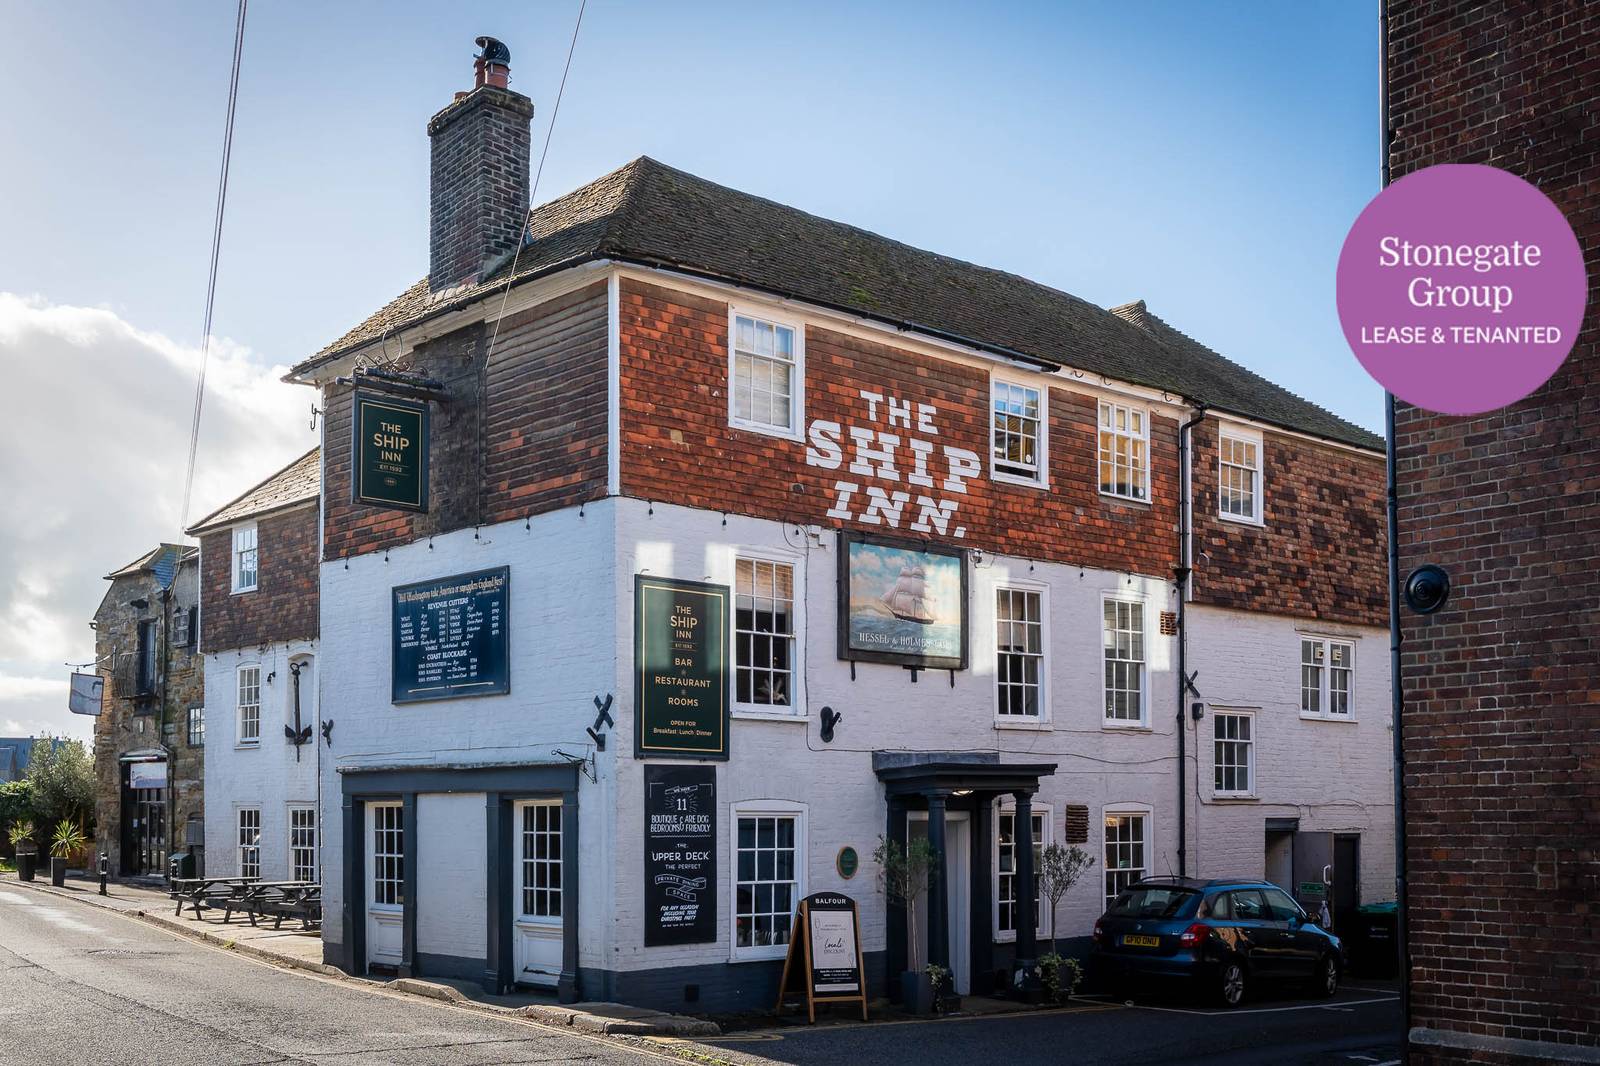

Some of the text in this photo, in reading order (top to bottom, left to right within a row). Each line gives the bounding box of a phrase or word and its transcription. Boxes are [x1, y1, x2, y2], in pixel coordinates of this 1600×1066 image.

[860, 389, 939, 434] THE
[380, 421, 402, 434] THE
[373, 433, 410, 450] SHIP
[381, 450, 402, 462] INN
[806, 419, 982, 494] SHIP
[427, 597, 469, 610] REVENUE CUTTERS
[675, 606, 692, 615] THE
[670, 615, 698, 628] SHIP
[675, 630, 692, 639] INN
[427, 649, 467, 660] COAST BLOCKADE
[674, 658, 692, 667] BAR
[655, 676, 712, 688] RESTAURANT
[668, 697, 699, 707] ROOMS
[653, 727, 677, 735] Breakfast
[677, 798, 687, 811] 11
[651, 815, 678, 824] BOUTIQUE
[684, 815, 697, 823] ARE
[697, 815, 710, 823] DOG
[650, 824, 711, 832] BEDROOMS FRIENDLY
[652, 851, 709, 861] UPPER DECK
[672, 889, 690, 900] SPACE
